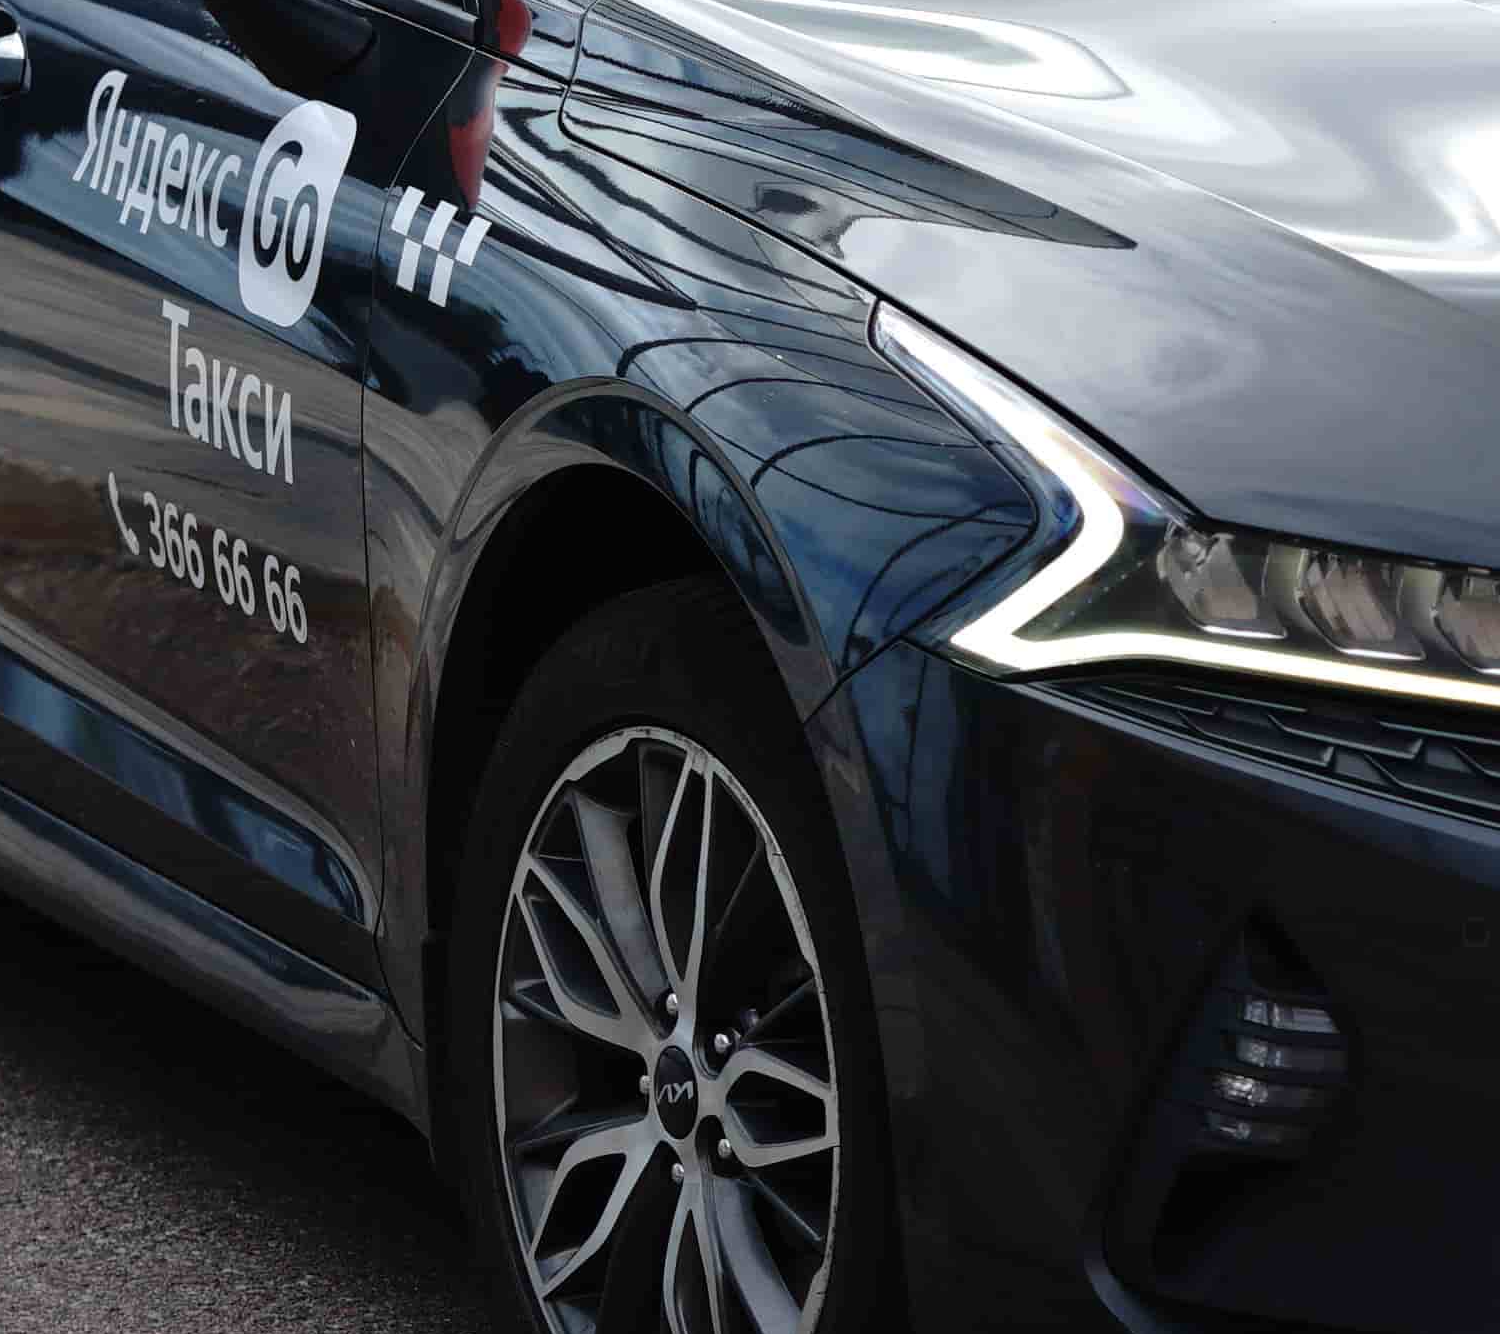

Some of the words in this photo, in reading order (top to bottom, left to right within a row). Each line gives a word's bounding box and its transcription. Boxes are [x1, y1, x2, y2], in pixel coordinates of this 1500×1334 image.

[72, 69, 242, 248] Яндекс
[252, 139, 319, 283] Go
[162, 299, 294, 485] Такси
[143, 491, 205, 589] 366
[212, 528, 255, 616] 66
[263, 554, 308, 644] 66
